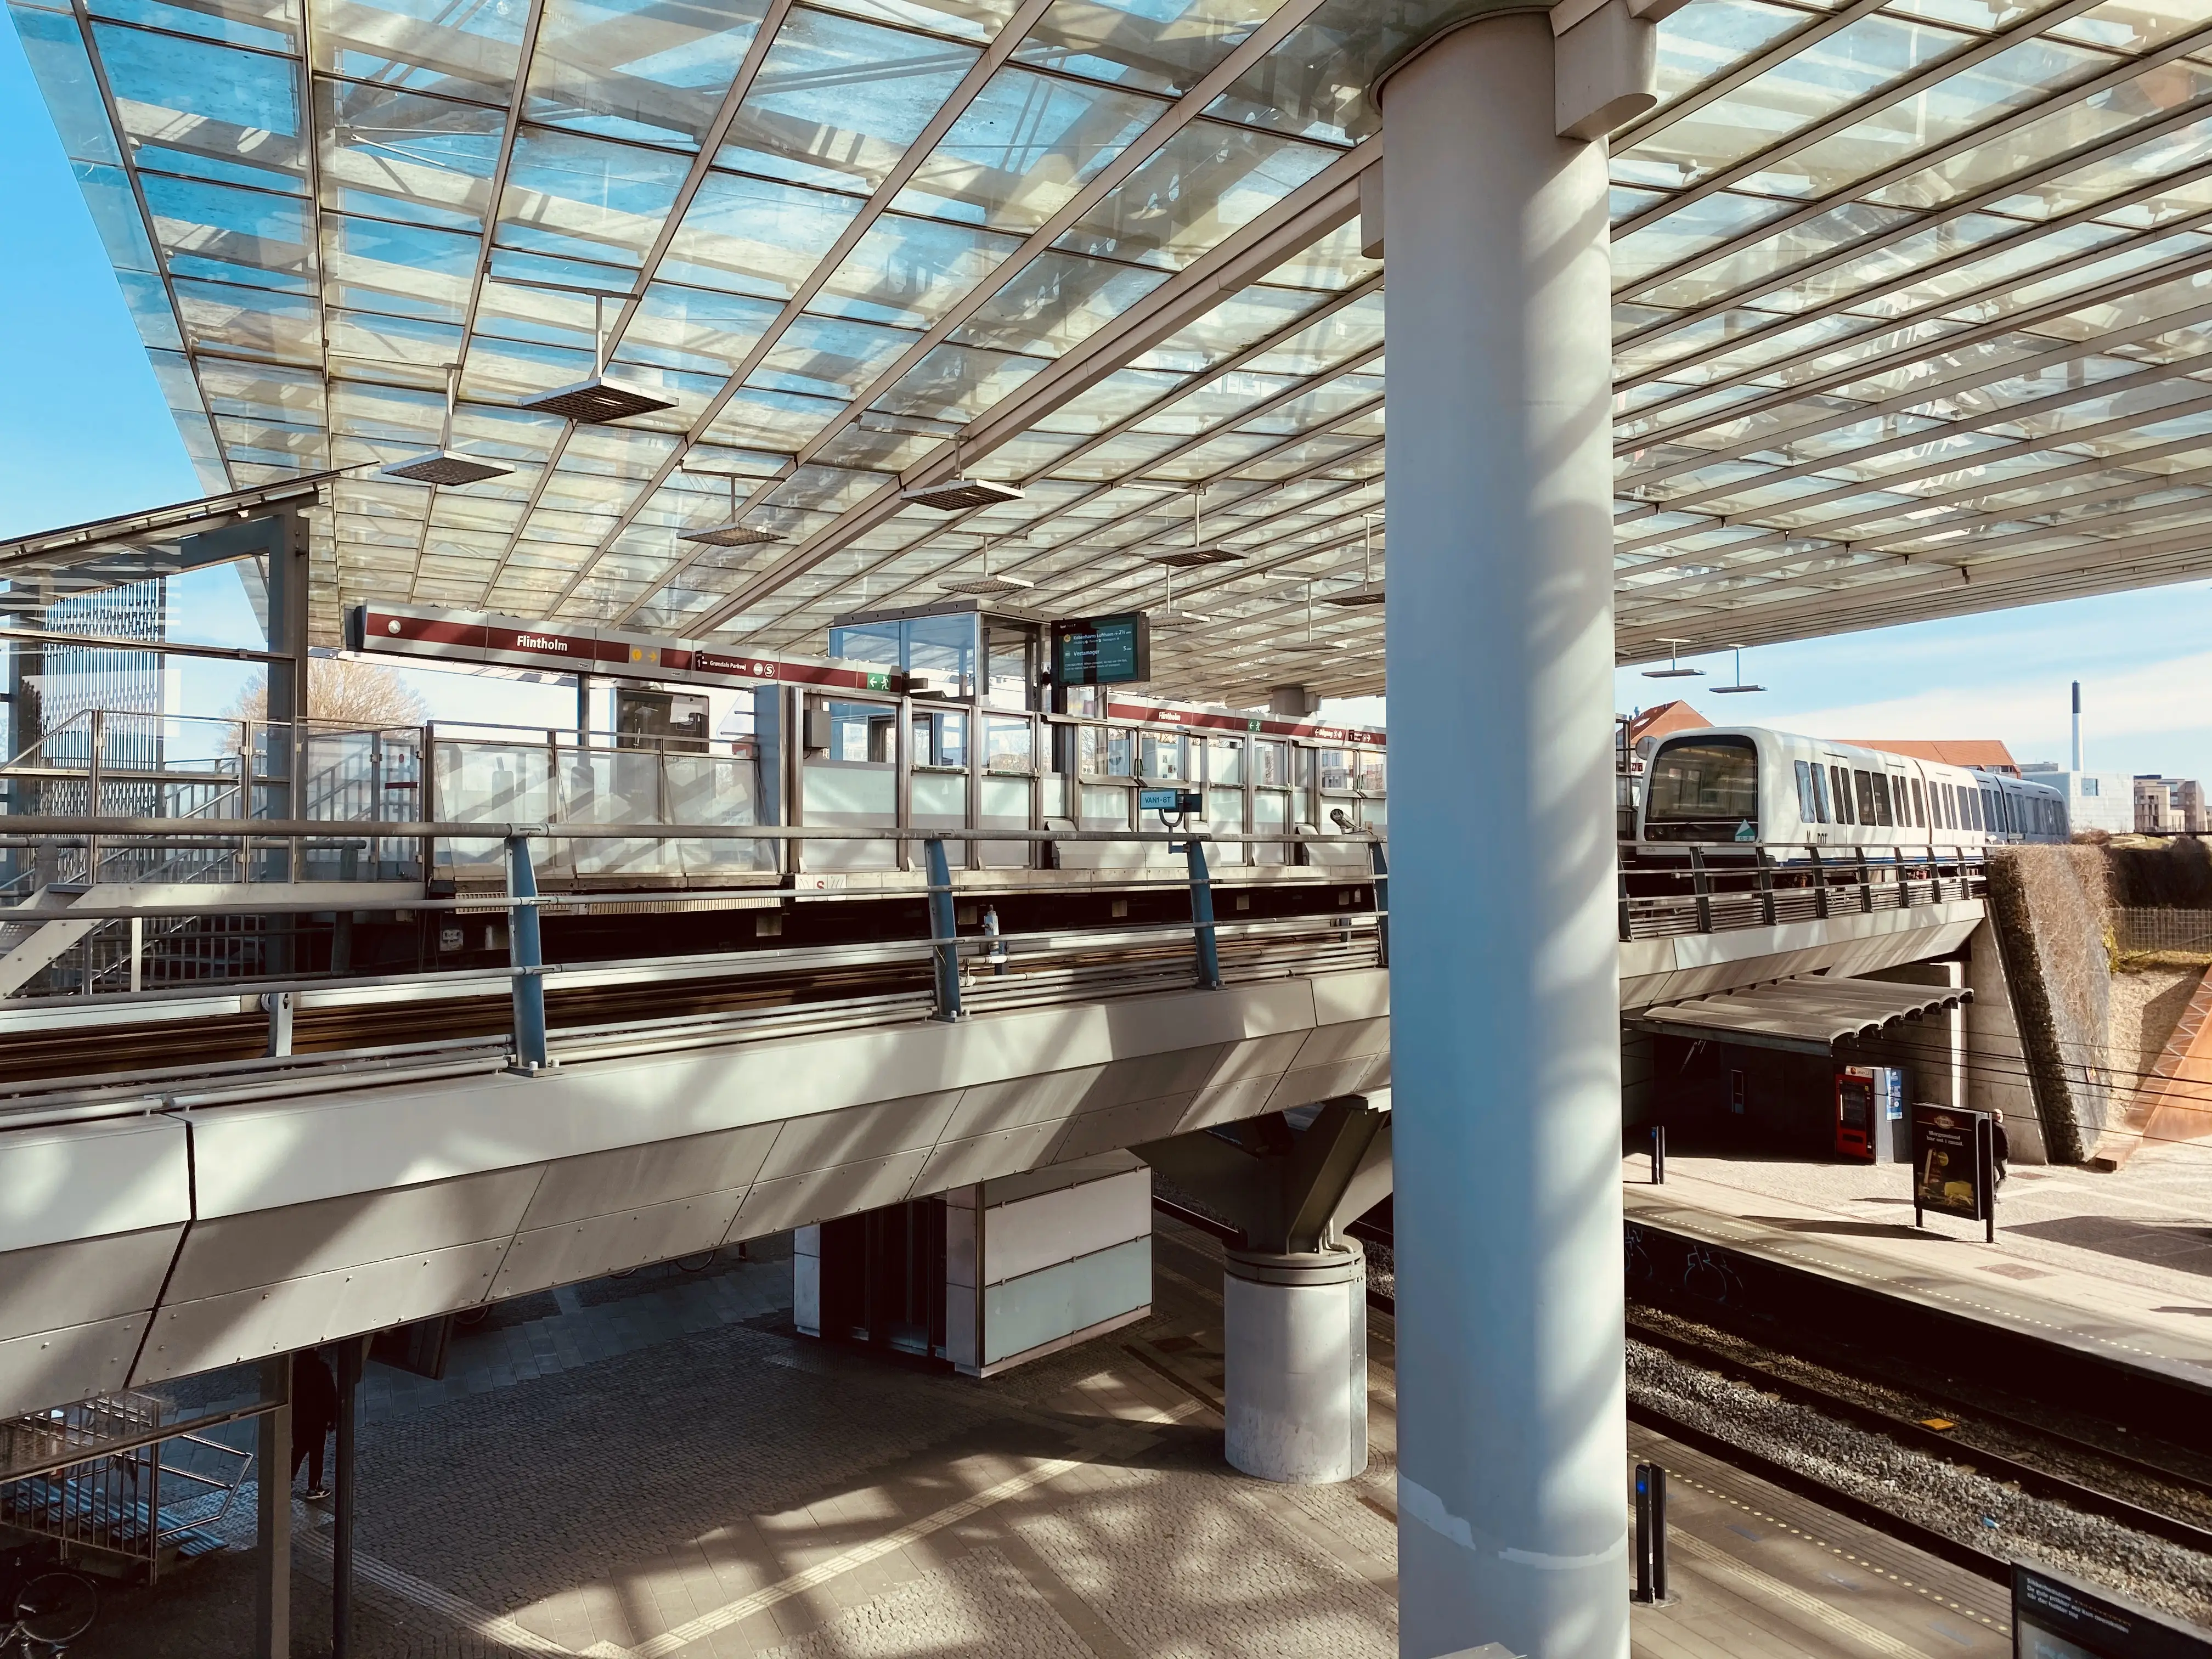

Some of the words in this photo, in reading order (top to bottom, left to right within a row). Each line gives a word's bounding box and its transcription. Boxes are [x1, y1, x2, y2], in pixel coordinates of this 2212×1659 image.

[517, 635, 568, 651] Flintholm
[709, 660, 730, 668] Grøndals
[730, 663, 747, 671] Parkvej
[1158, 712, 1181, 721] Flintholm
